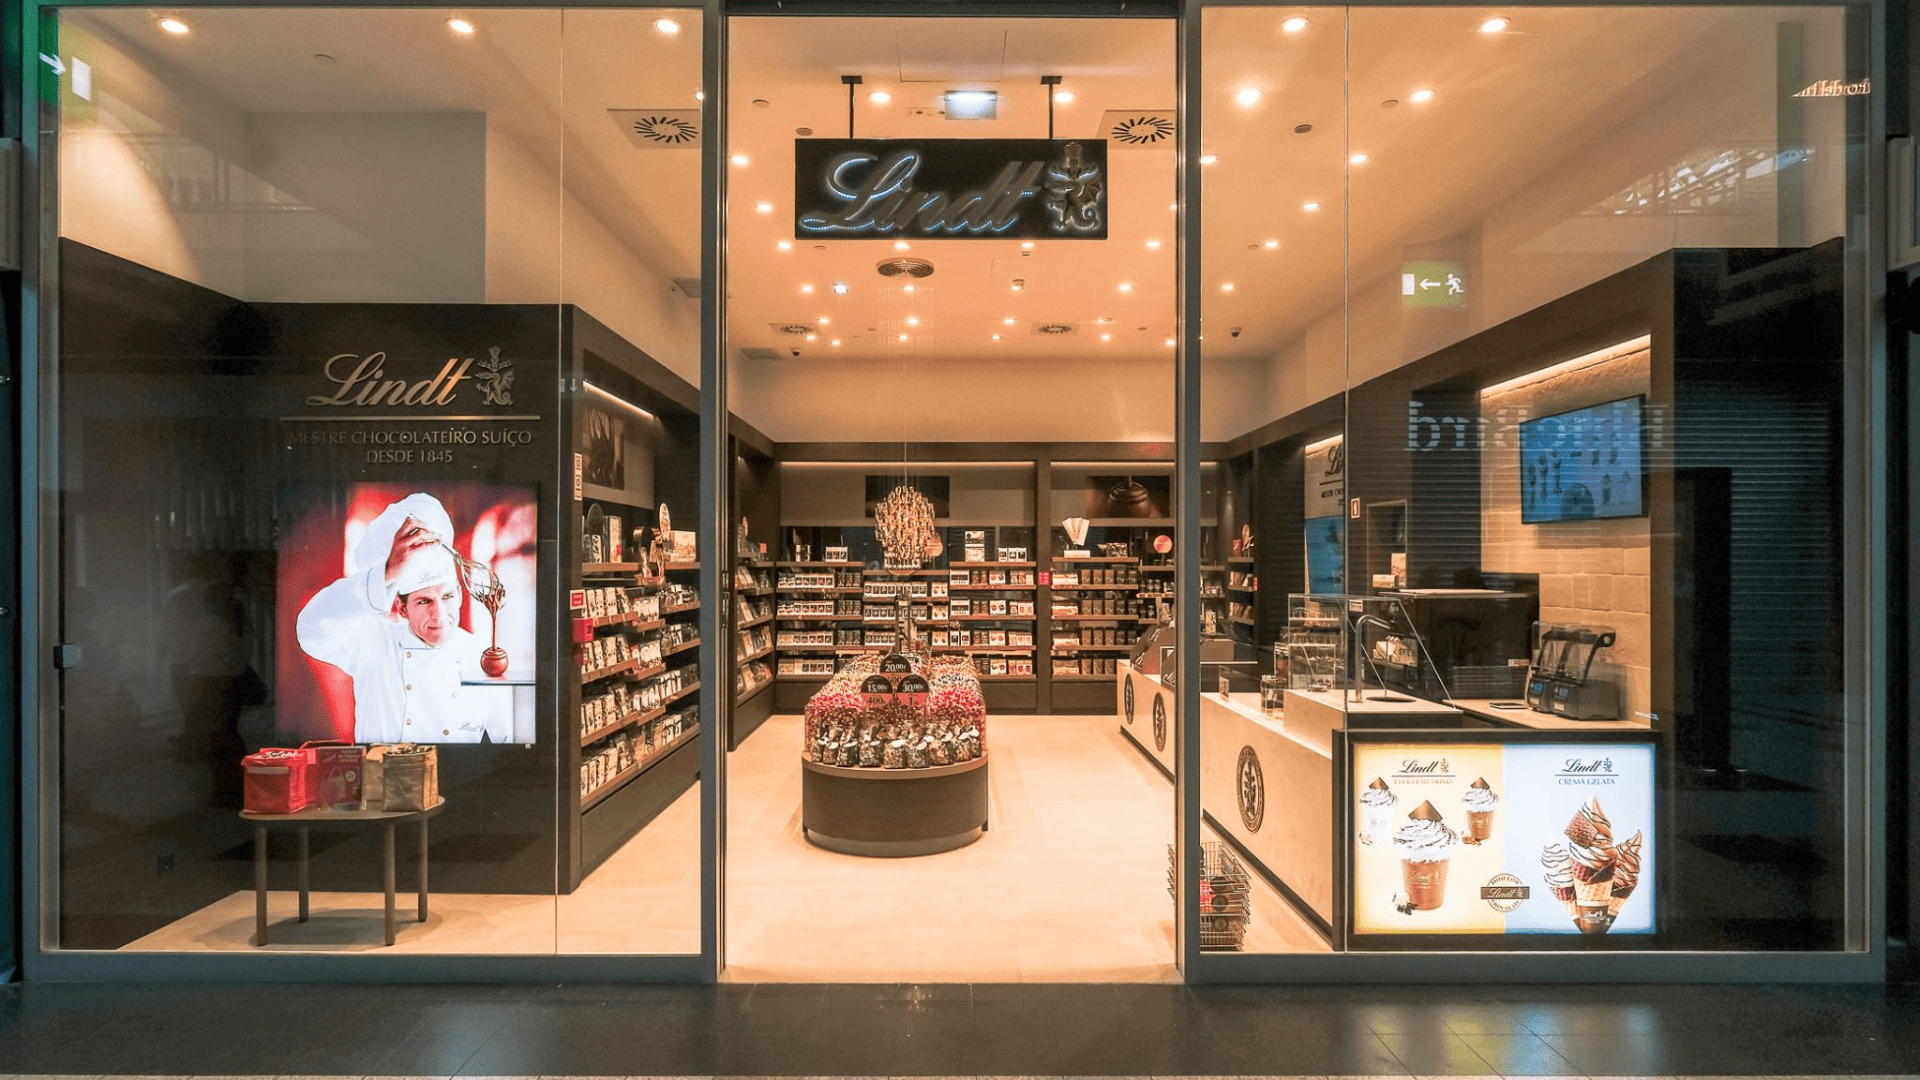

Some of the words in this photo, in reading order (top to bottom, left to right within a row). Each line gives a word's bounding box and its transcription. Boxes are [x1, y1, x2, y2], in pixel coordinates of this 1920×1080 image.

[800, 151, 1046, 231] Lindt
[305, 351, 475, 406] Lindt
[289, 431, 347, 445] MESTRE
[351, 430, 477, 445] CHOCOLATEIRO
[482, 428, 532, 447] SUÍÇO
[366, 450, 414, 463] DESDE
[420, 450, 453, 463] 1845
[1399, 759, 1439, 773] Lindt
[1562, 758, 1603, 772] Lindt
[1487, 888, 1517, 897] Lindt
